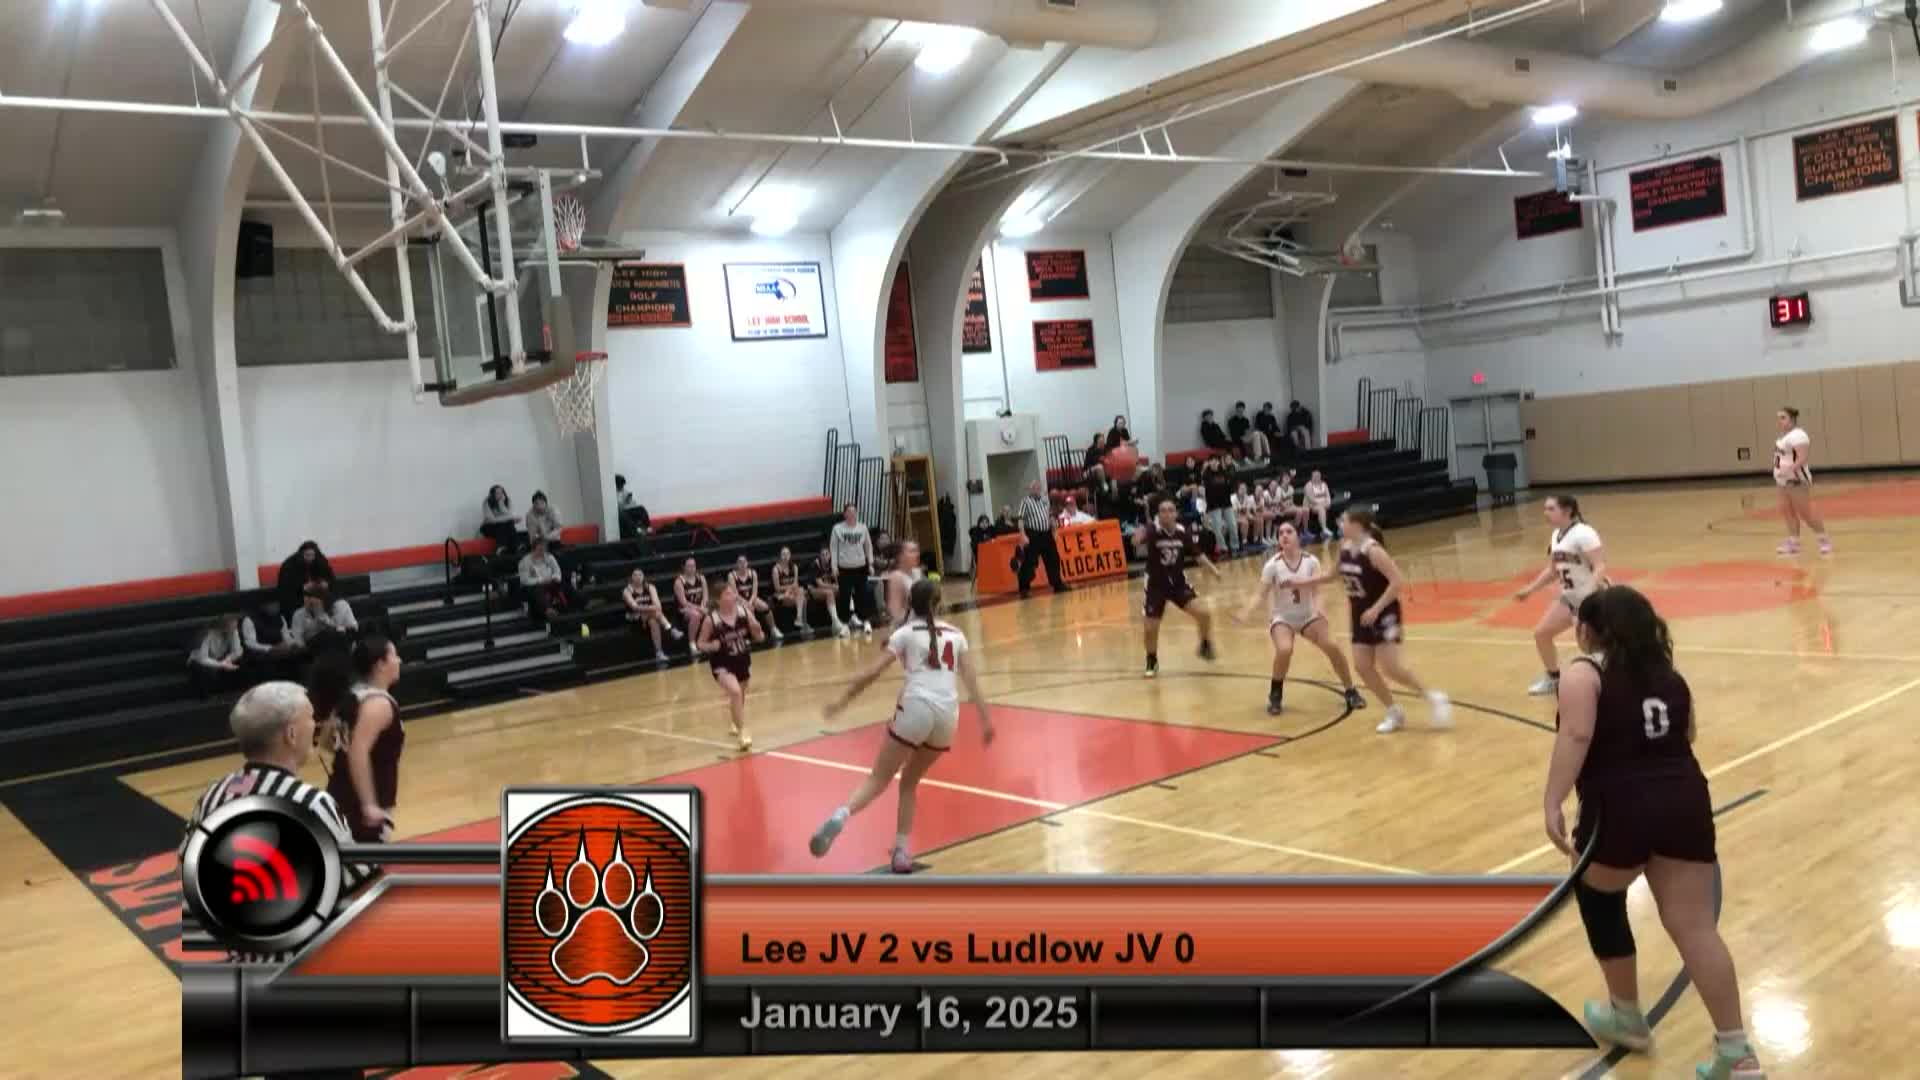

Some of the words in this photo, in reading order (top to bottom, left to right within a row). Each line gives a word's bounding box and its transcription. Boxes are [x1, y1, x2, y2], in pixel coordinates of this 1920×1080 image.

[1802, 140, 1890, 165] FOOTBALL
[1804, 160, 1892, 187] CHAMPIONS
[629, 291, 657, 300] GOLF
[615, 304, 676, 313] CHAMPIONS
[1777, 300, 1803, 322] 31
[1062, 530, 1100, 553] LEE
[1060, 550, 1123, 578] ILDCATS
[1642, 698, 1670, 739] 0
